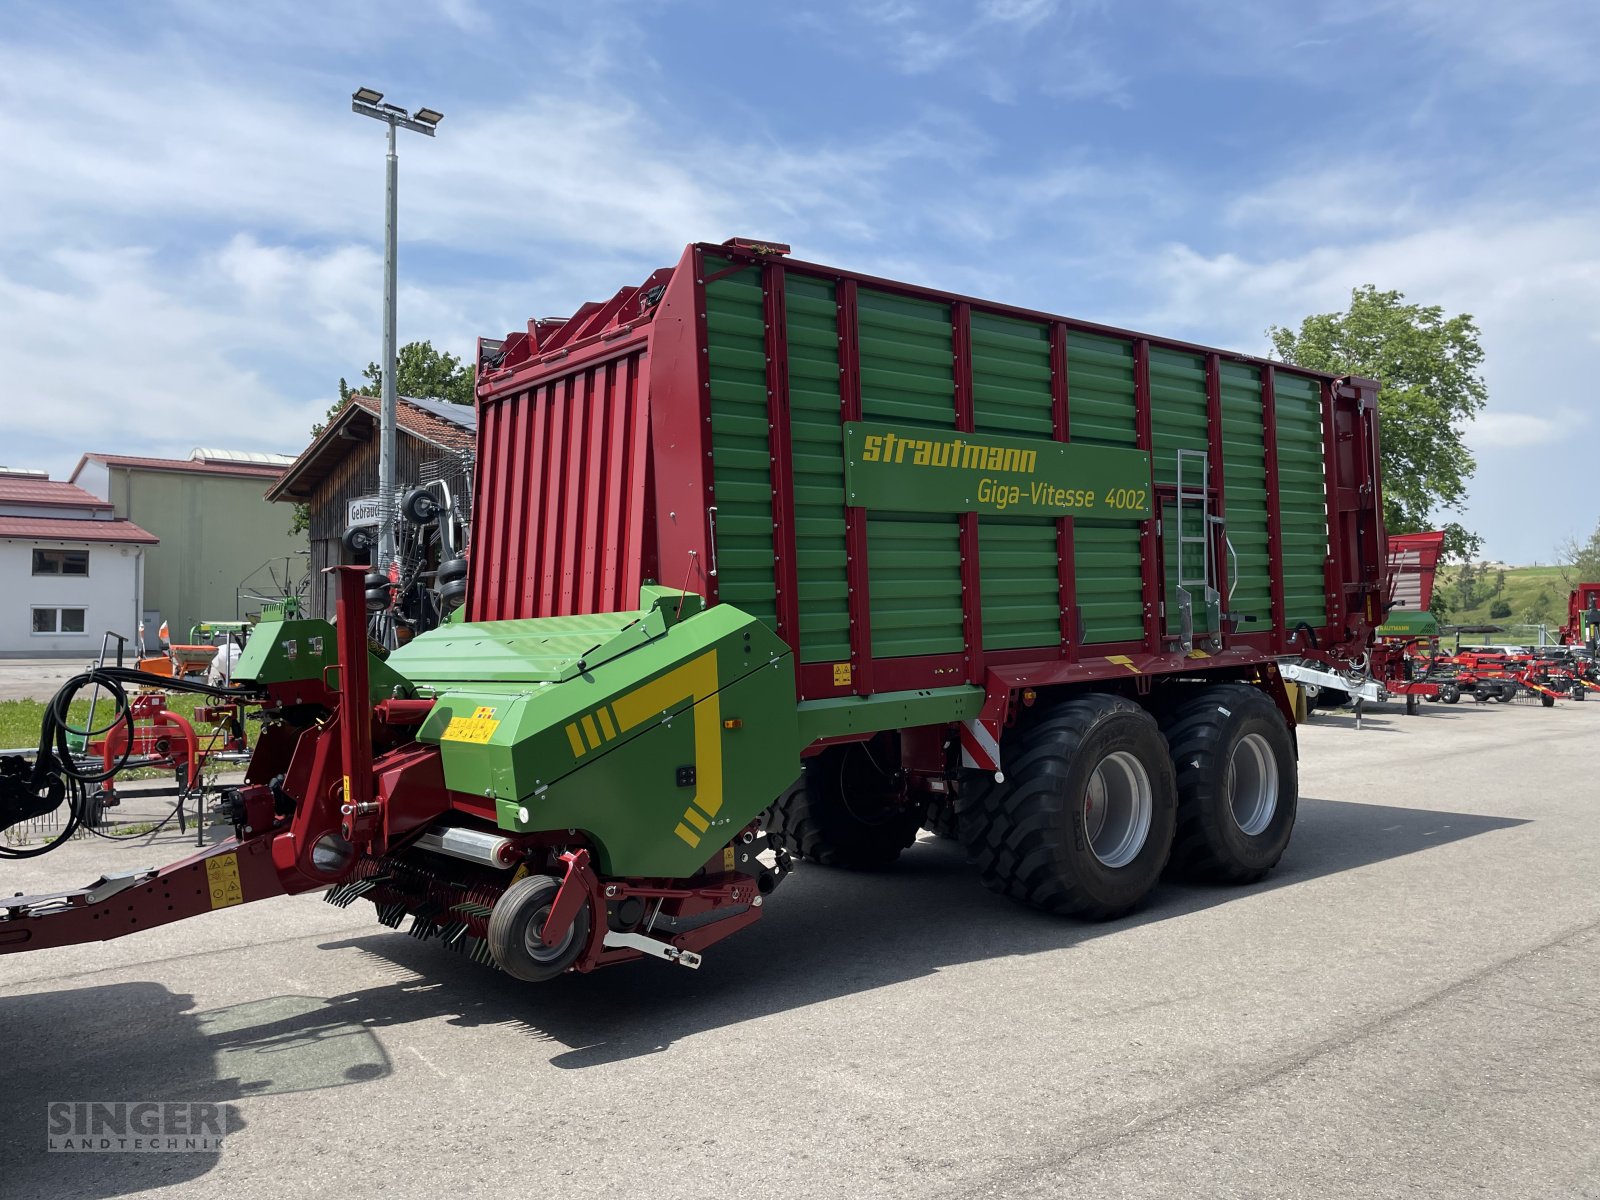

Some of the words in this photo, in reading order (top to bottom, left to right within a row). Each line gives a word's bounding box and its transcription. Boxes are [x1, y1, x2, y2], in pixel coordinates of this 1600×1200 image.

[863, 433, 1036, 473] strautmann
[978, 478, 1095, 509] Giga-Vitesse
[1105, 488, 1146, 510] 4002
